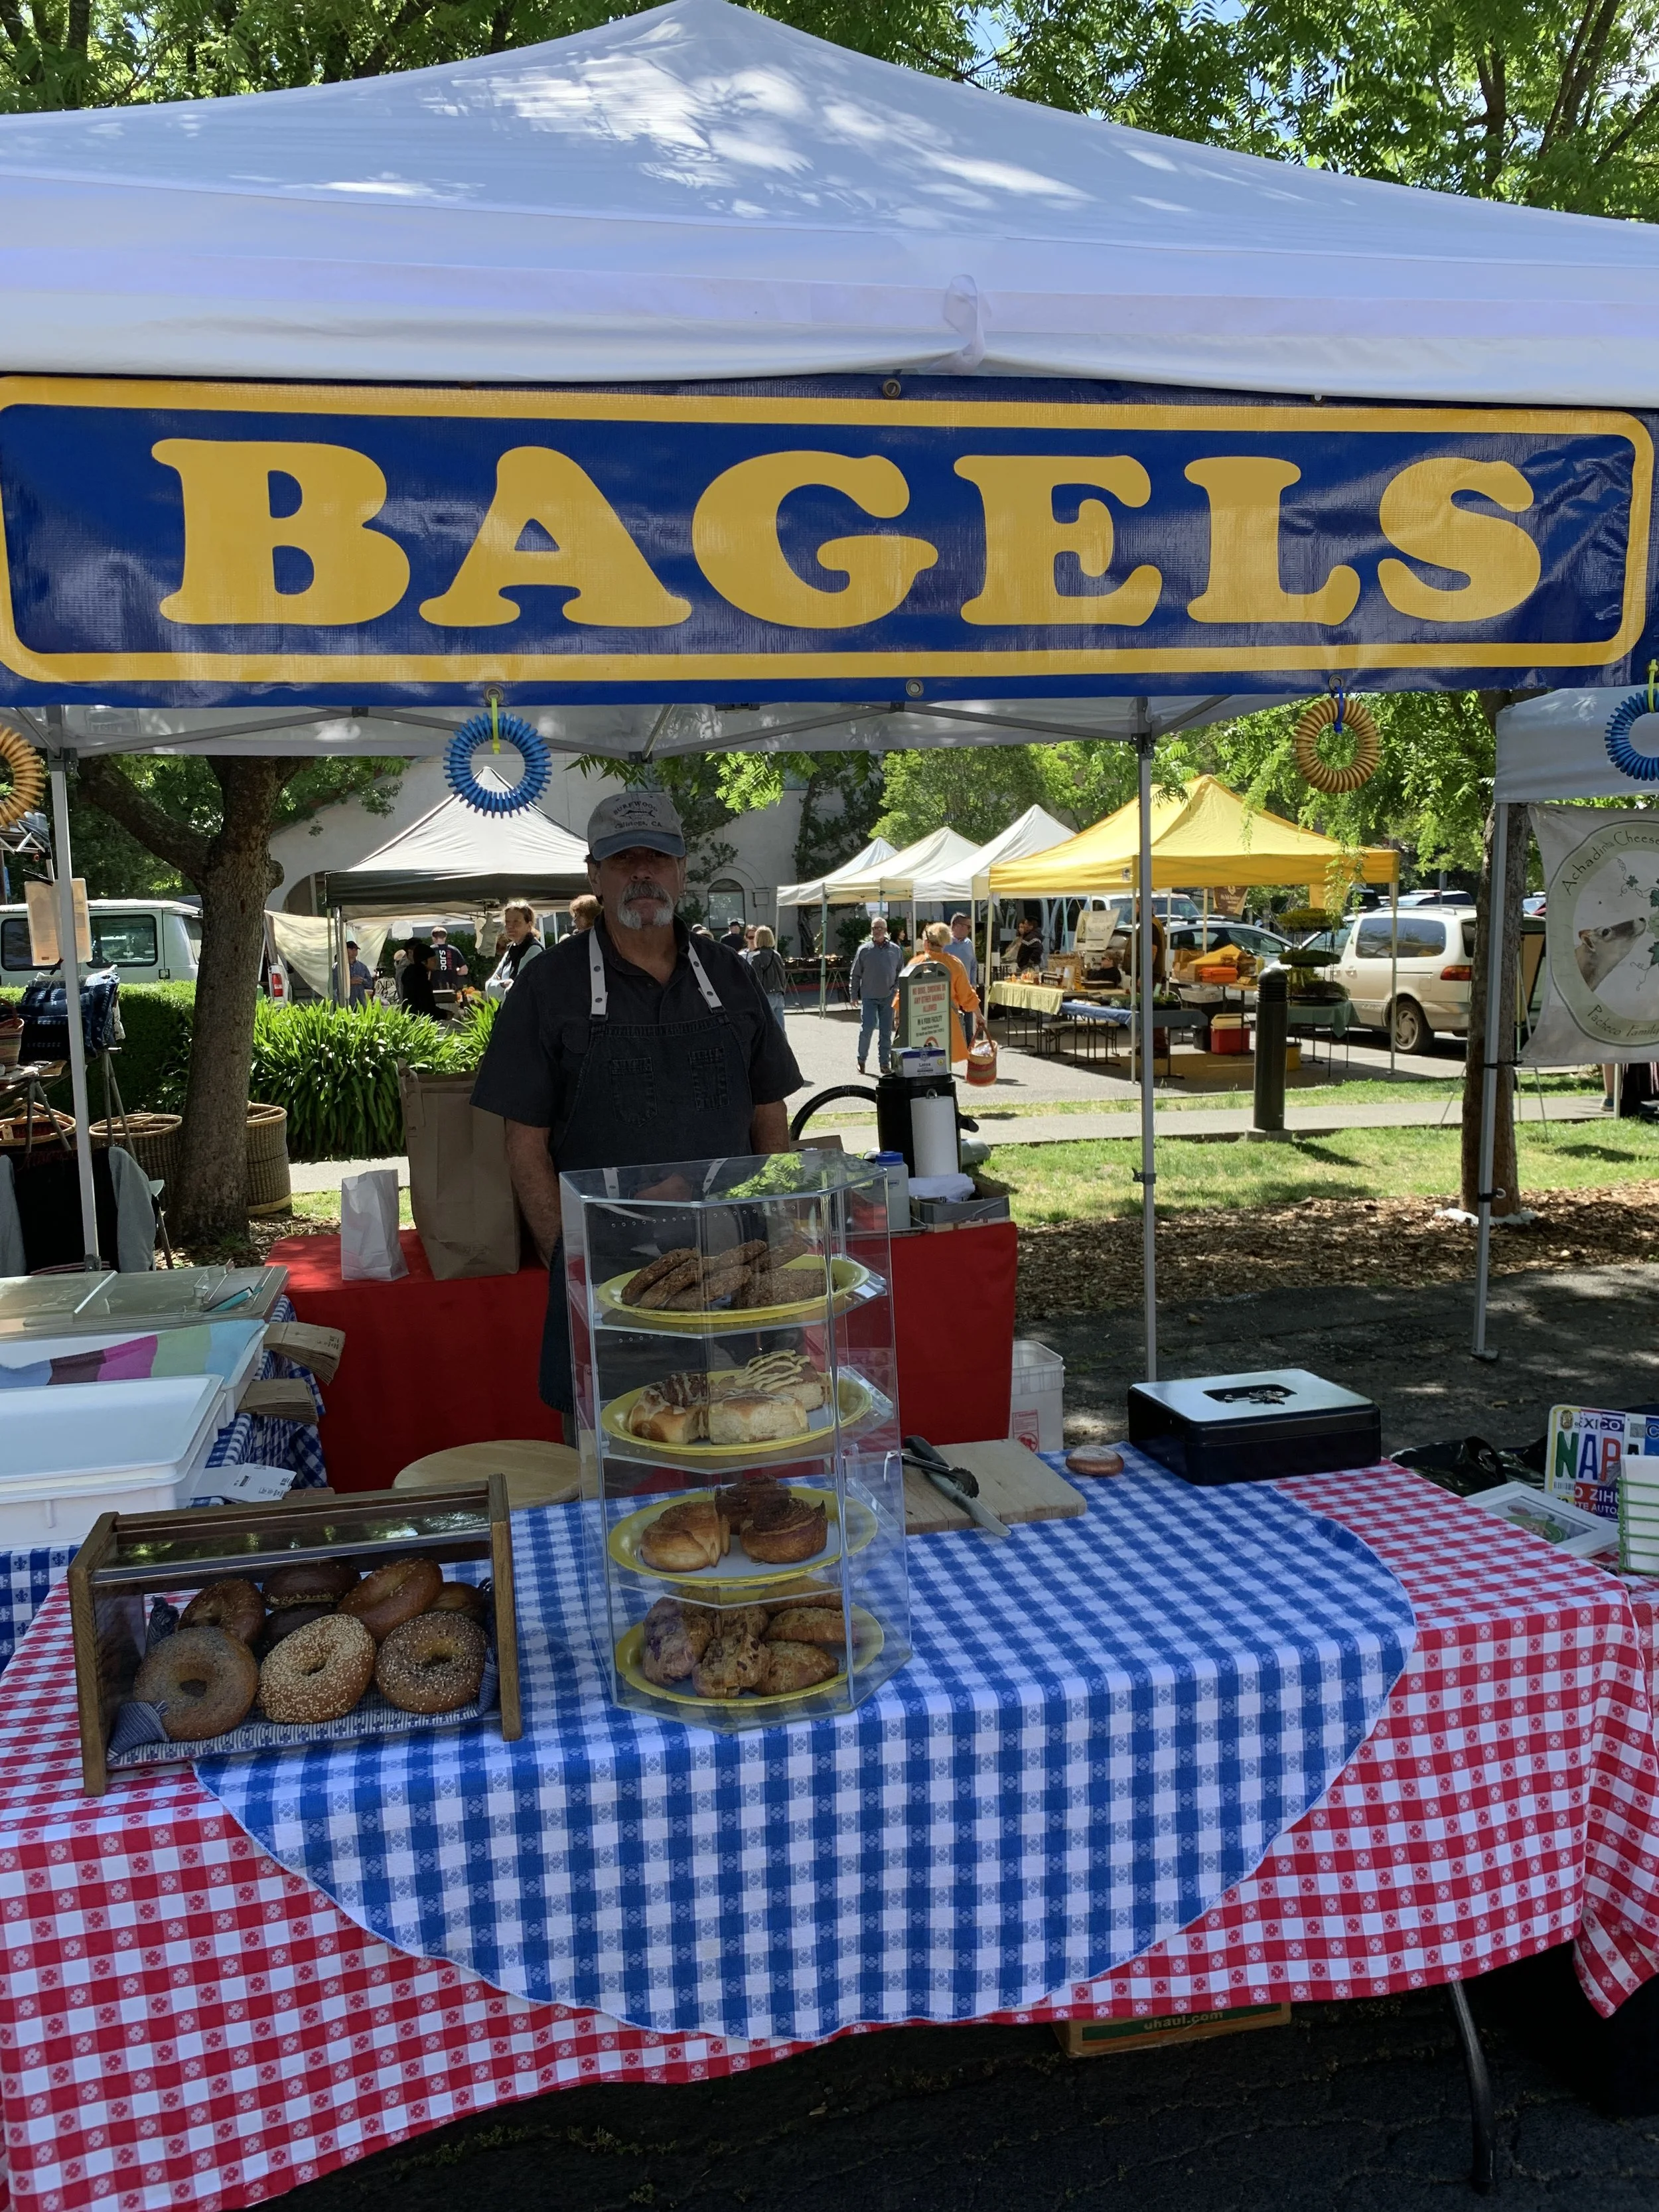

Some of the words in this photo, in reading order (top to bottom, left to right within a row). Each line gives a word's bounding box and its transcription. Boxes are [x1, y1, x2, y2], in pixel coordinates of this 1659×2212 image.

[152, 438, 1541, 628] BAGELS
[1587, 1004, 1621, 1035] Pacheco
[1143, 2012, 1223, 2029] uhaul.com
